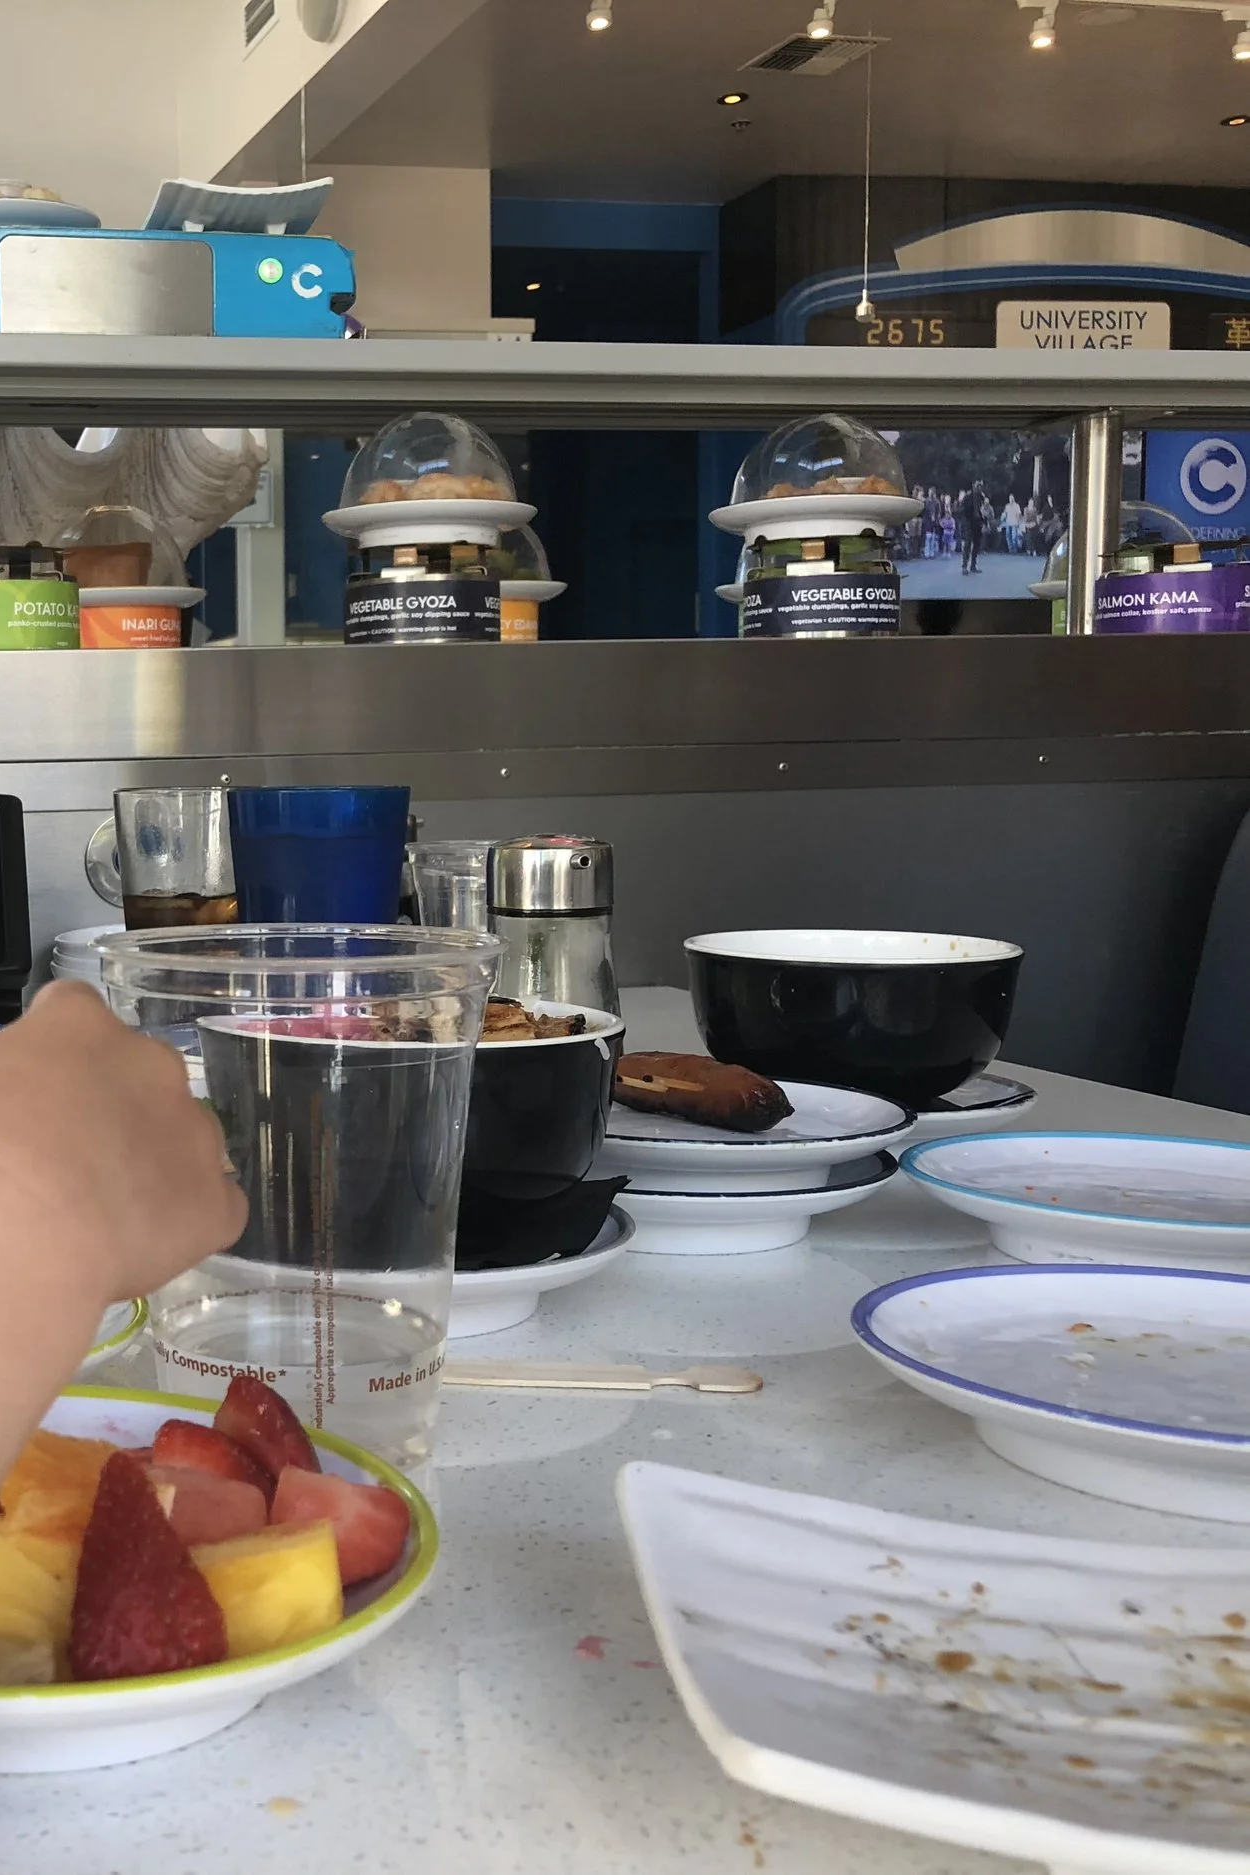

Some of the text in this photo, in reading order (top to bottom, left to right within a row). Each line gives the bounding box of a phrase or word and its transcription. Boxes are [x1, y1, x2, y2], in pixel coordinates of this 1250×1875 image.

[291, 263, 323, 299] C
[1019, 310, 1149, 331] UNIVERSITY
[866, 318, 946, 345] 2675
[1034, 334, 1133, 350] VILLAGE
[350, 596, 457, 614] VEGETABLE GYOZA
[791, 588, 897, 602] VEGETABLE GYOZA
[1098, 590, 1199, 610] SALMON KAMA
[14, 602, 65, 616] POTATO
[425, 611, 451, 619] dipping
[777, 604, 810, 613] vegetable
[1142, 608, 1168, 616] kosher
[1188, 606, 1212, 614] ponzu
[122, 618, 158, 631] INARI
[324, 1293, 335, 1347] composting
[310, 1321, 323, 1380] Compostable
[325, 1349, 335, 1405] Appropriate
[368, 1371, 412, 1393] Made
[415, 1367, 426, 1382] in
[312, 1382, 323, 1430] ndustrially
